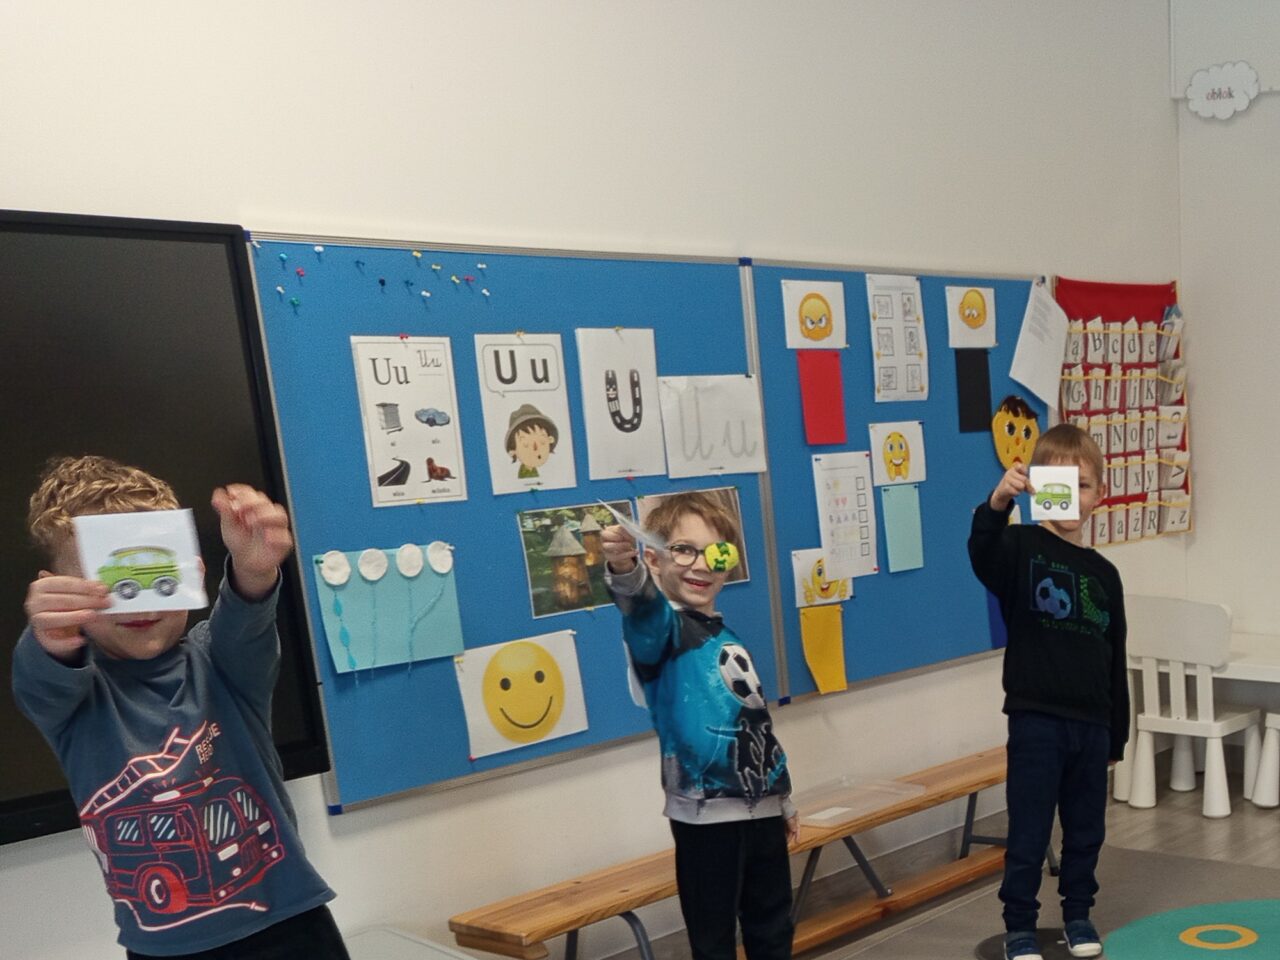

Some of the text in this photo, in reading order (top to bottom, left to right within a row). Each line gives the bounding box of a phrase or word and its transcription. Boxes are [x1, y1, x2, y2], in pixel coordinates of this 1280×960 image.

[370, 357, 411, 386] Uu
[493, 350, 550, 385] U u
[605, 369, 643, 433] U
